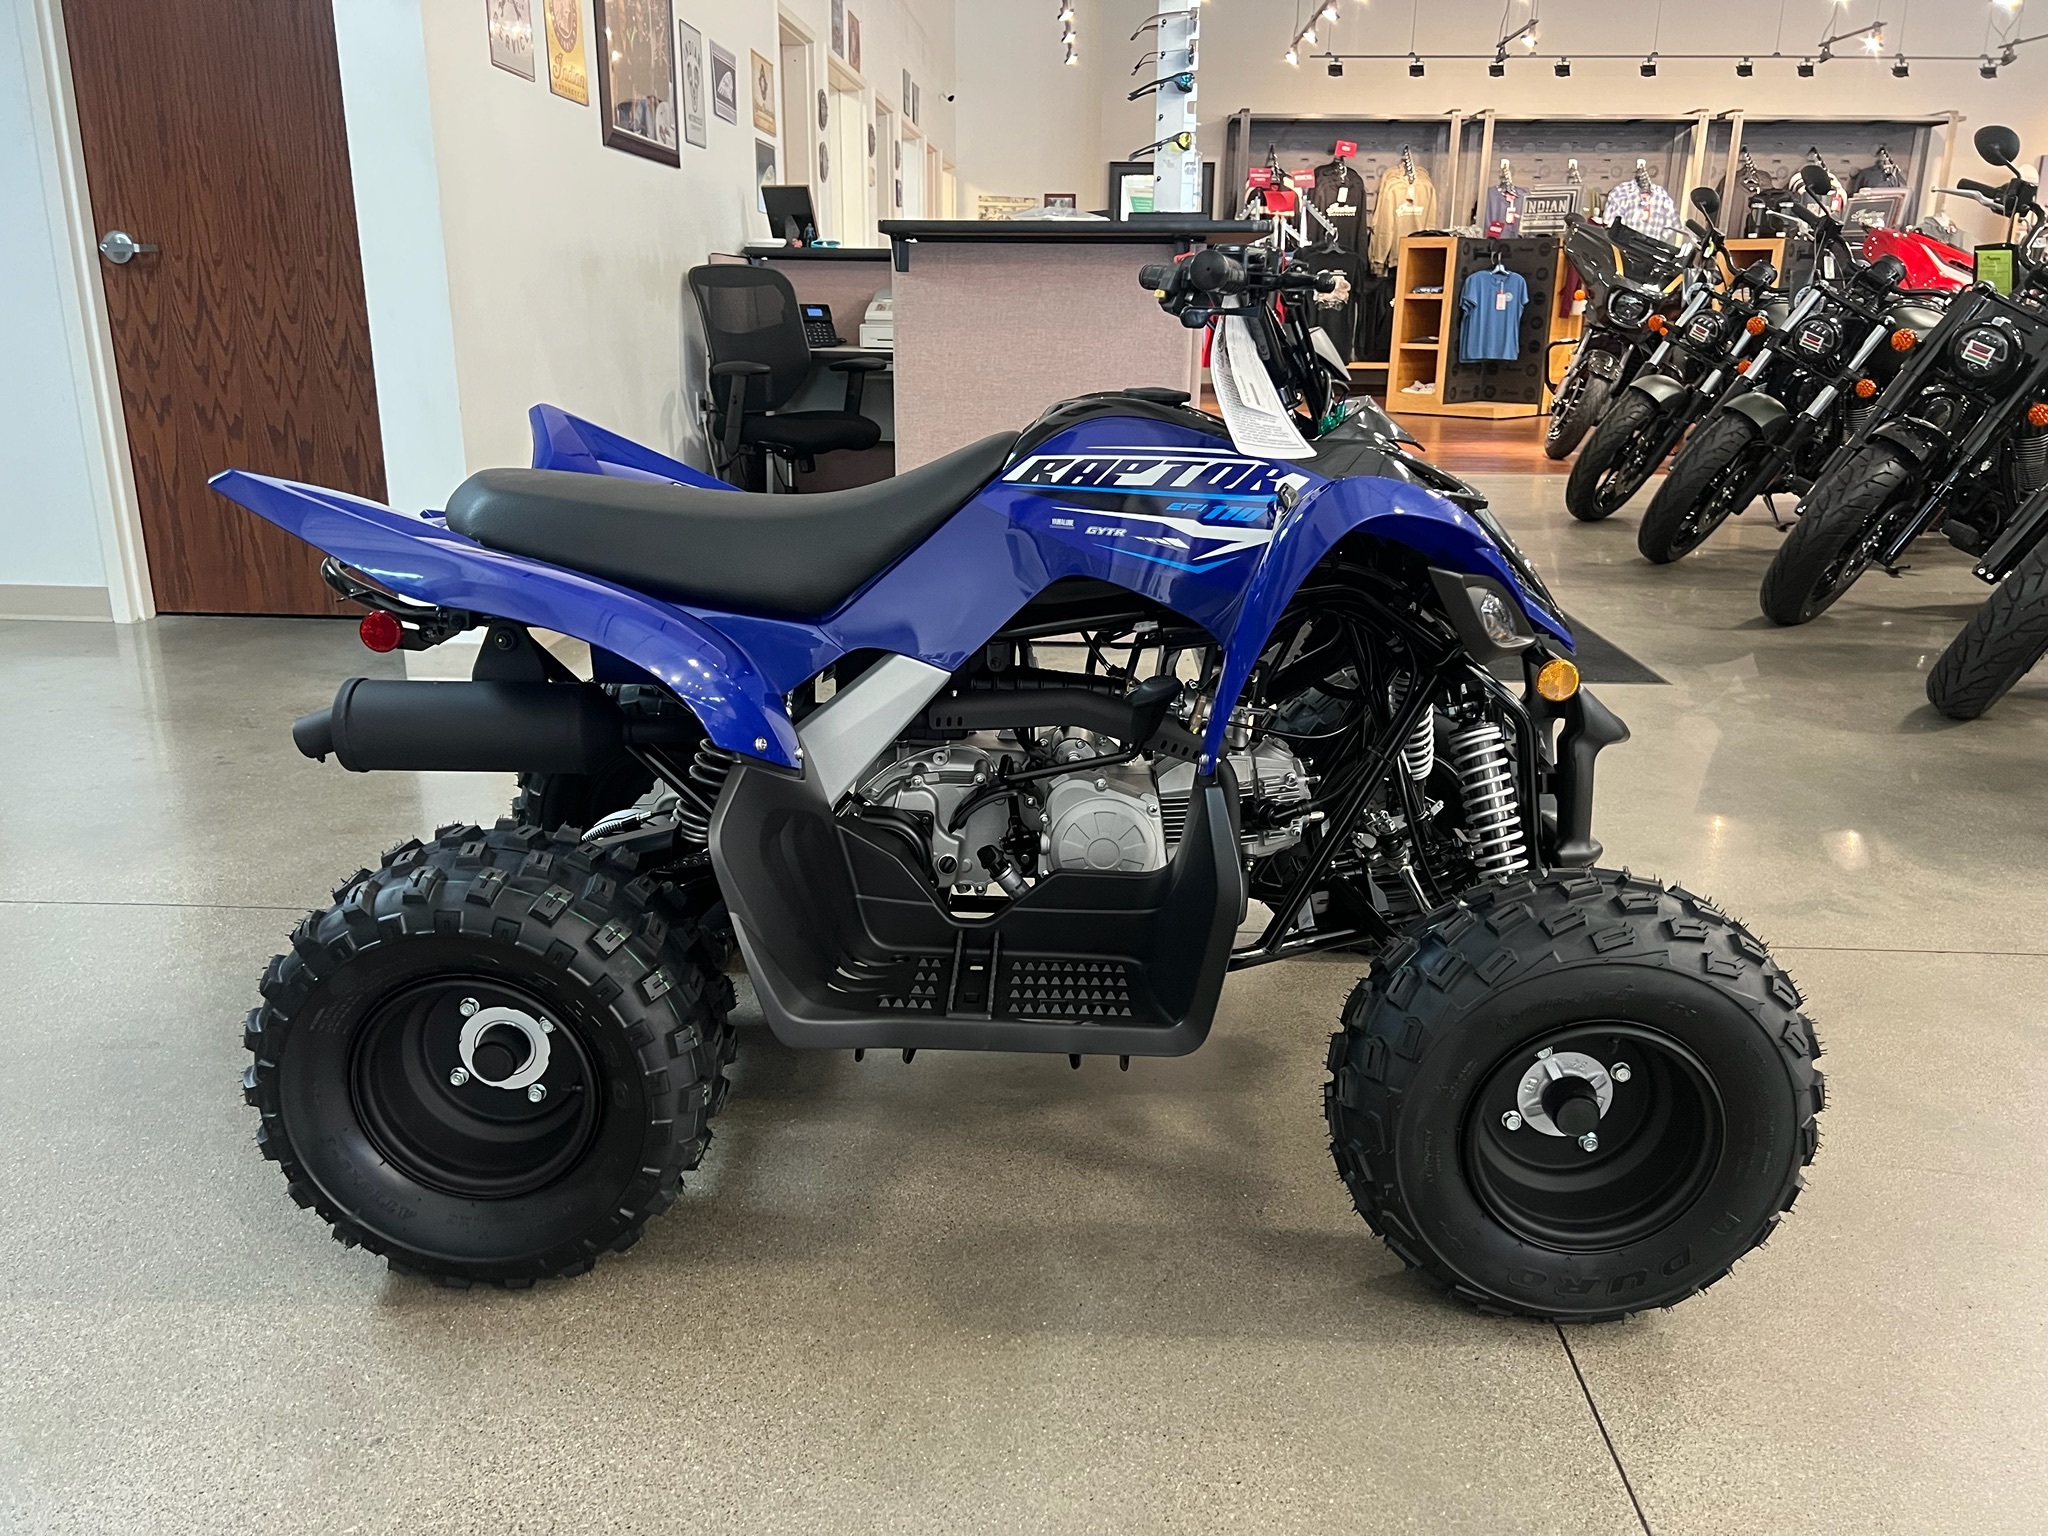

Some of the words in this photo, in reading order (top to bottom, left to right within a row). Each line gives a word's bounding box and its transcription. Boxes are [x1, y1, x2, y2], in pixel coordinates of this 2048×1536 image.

[552, 52, 586, 90] Indian
[1524, 199, 1568, 214] INDIAN
[1012, 456, 1298, 491] RAPTOR
[1166, 502, 1207, 512] EFI
[1203, 505, 1267, 522] 110
[1085, 526, 1128, 537] GYTR
[1507, 1244, 1693, 1298] DURO
